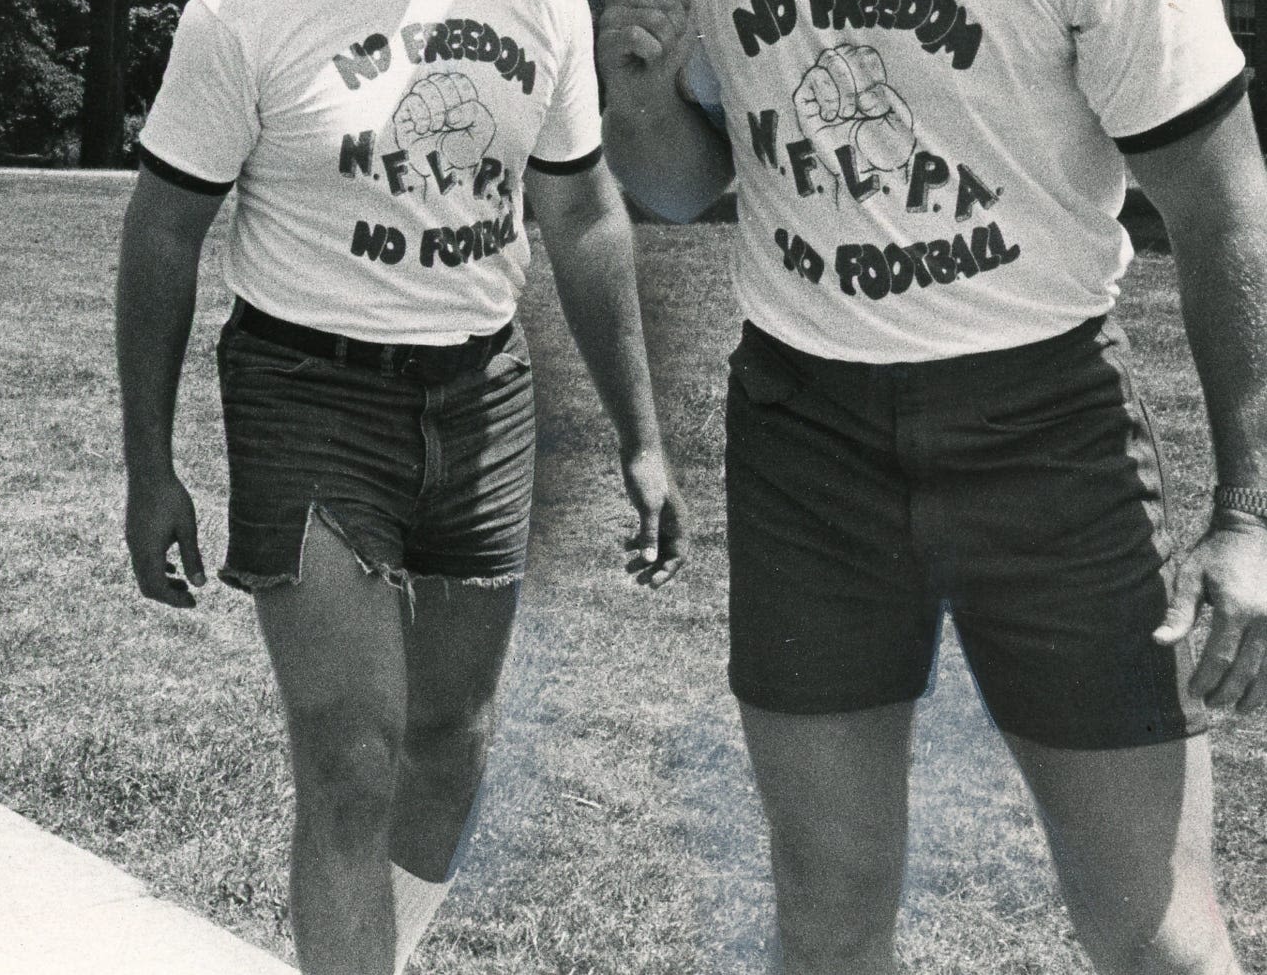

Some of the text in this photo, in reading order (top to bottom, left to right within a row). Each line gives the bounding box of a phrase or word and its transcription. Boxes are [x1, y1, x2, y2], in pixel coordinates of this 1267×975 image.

[333, 19, 536, 95] NO FREEDOM
[350, 220, 407, 265] NO
[774, 221, 1021, 300] NO FOOTBALL
